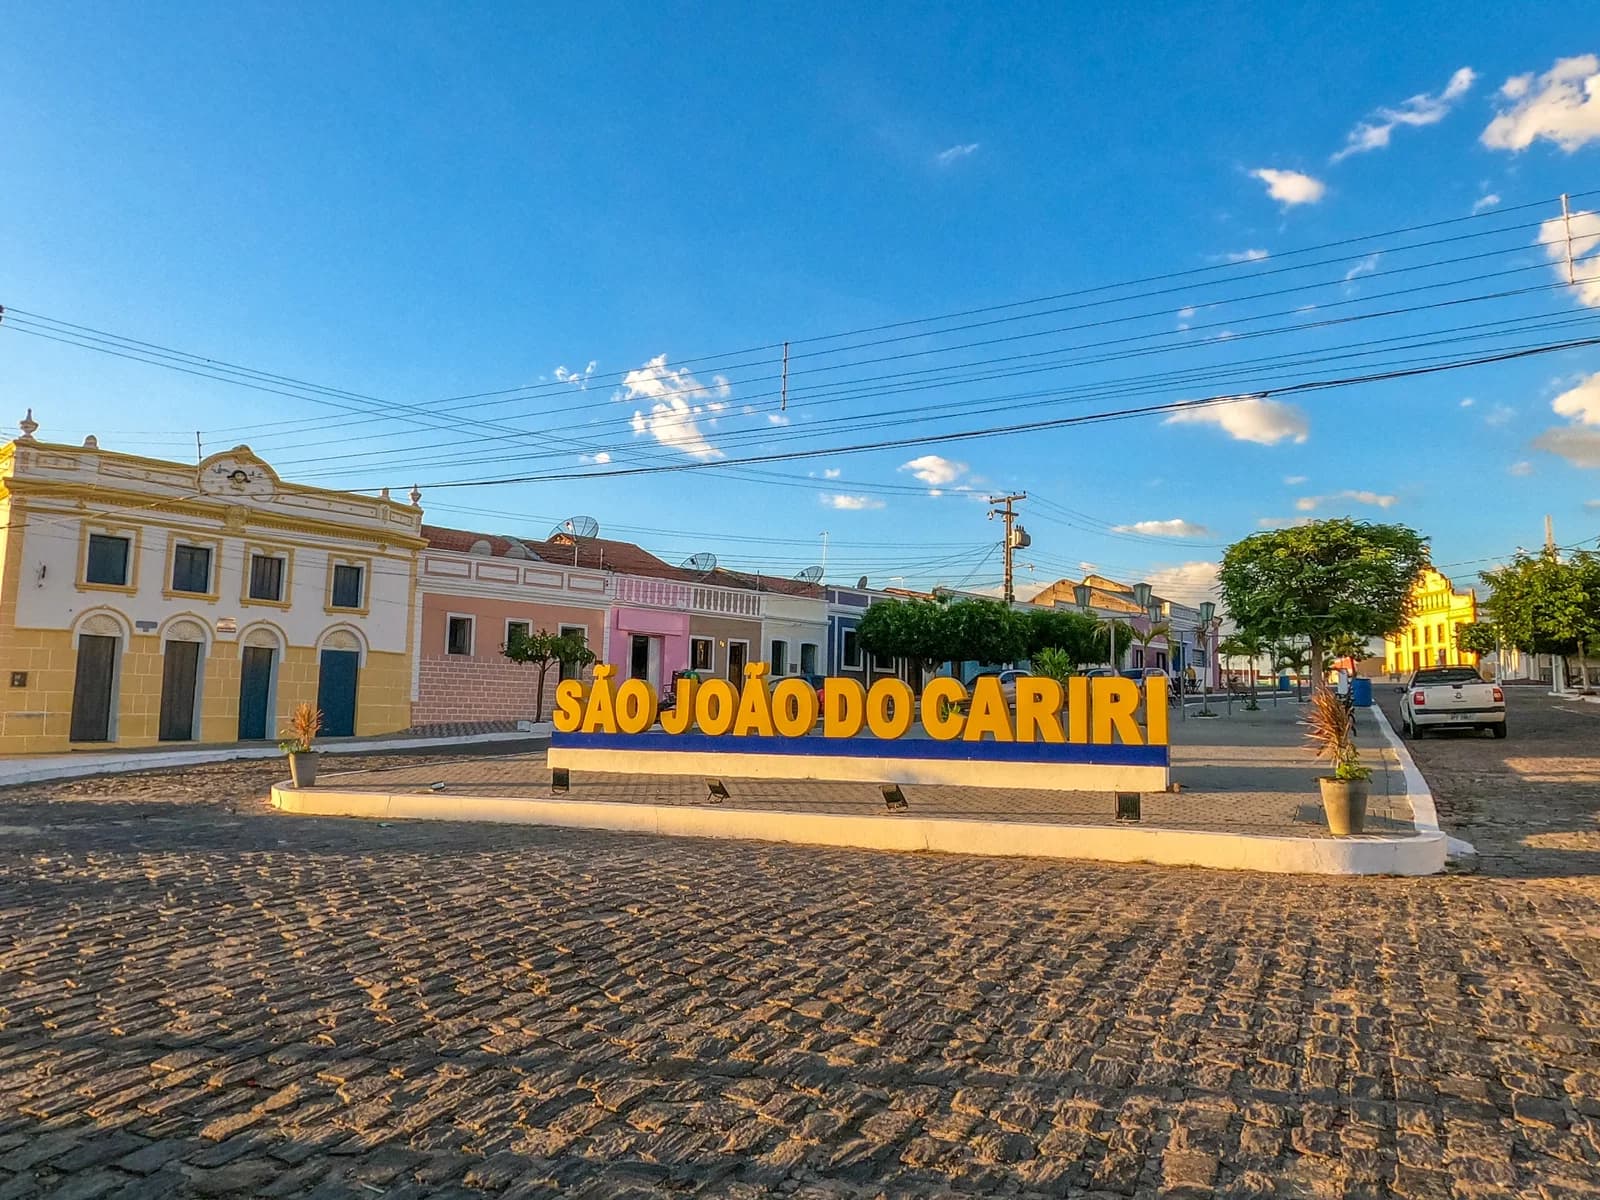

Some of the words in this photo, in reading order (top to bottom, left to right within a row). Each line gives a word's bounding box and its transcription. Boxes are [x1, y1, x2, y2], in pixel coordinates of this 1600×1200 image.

[553, 663, 658, 734] SÃO
[660, 662, 818, 738] JOÃO
[823, 677, 914, 739] DO
[921, 676, 1167, 745] CARIRI
